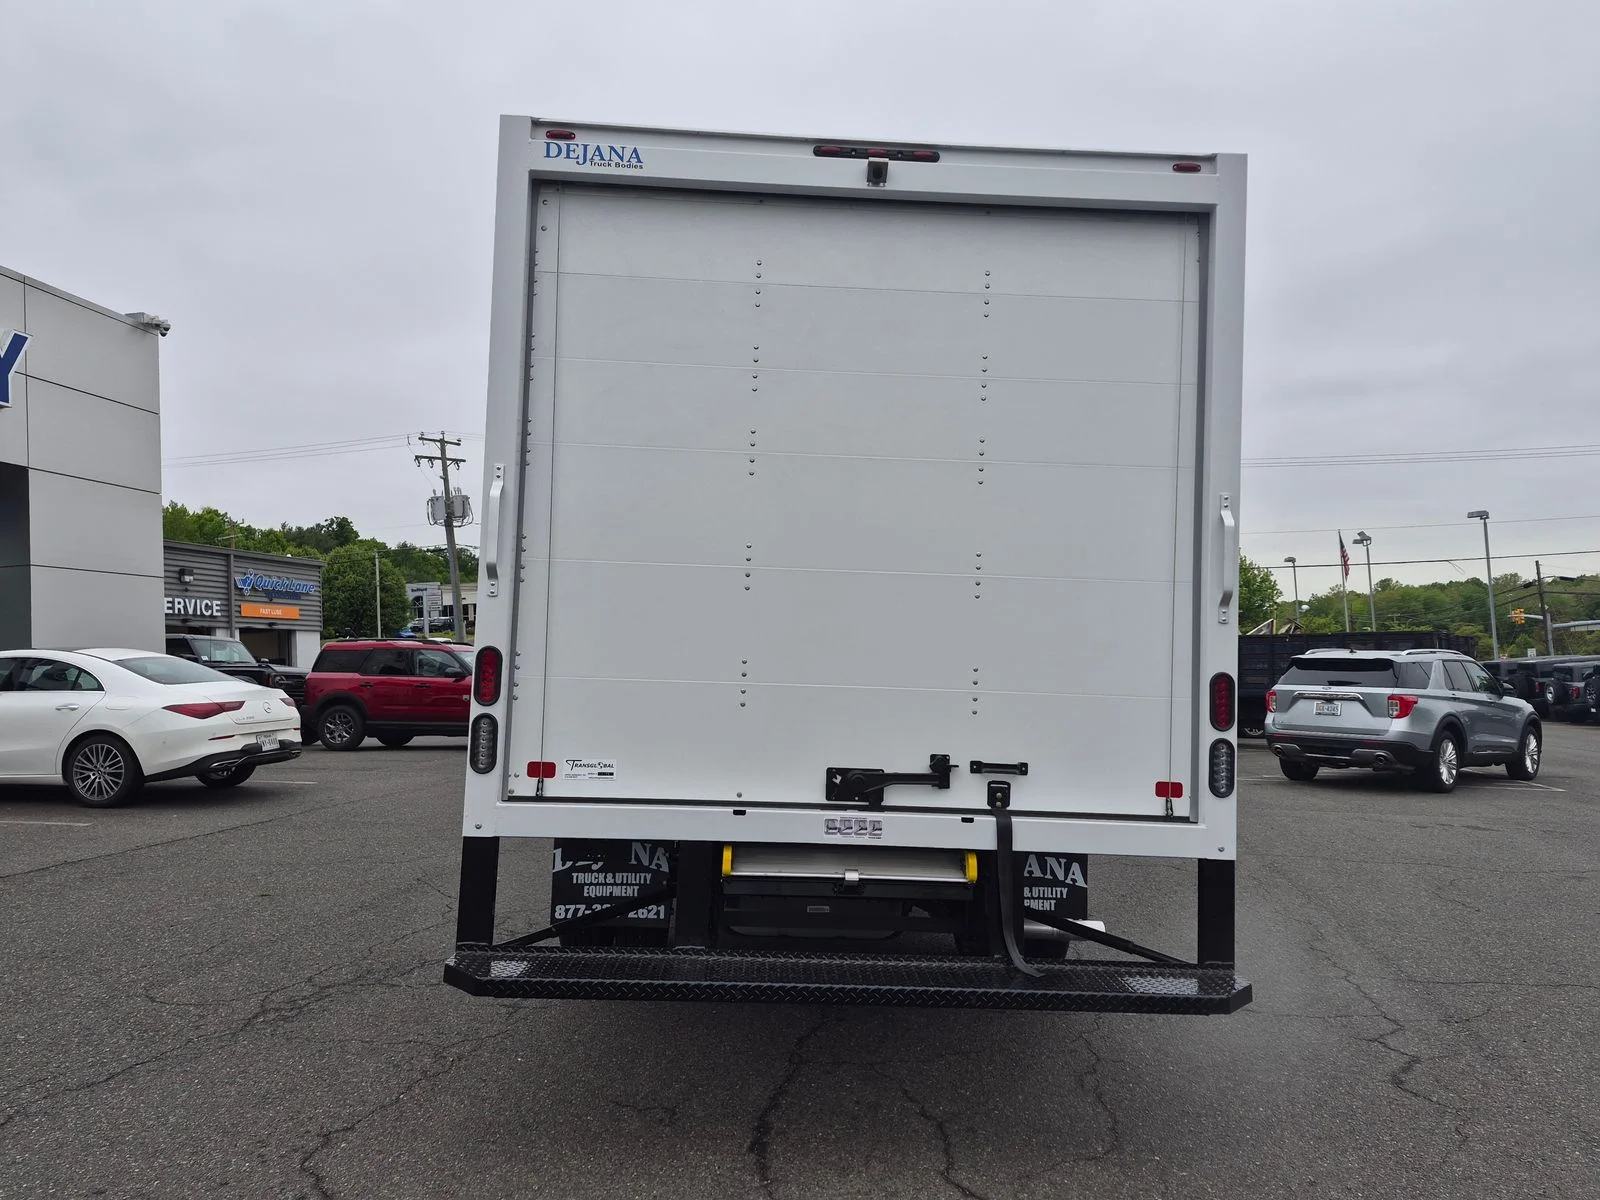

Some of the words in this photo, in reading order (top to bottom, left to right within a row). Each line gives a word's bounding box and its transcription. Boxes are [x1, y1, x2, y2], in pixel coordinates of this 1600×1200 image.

[543, 141, 644, 166] DEJANA
[589, 160, 612, 168] Truck
[614, 161, 644, 170] Bodies
[163, 597, 222, 616] ERVICE
[1024, 854, 1088, 887] ANA
[572, 873, 605, 884] TRUCK
[615, 873, 652, 884] UTILITY
[583, 885, 640, 898] EQUIPMENT
[1032, 887, 1068, 898] UTILITY
[1024, 900, 1056, 910] PMENT
